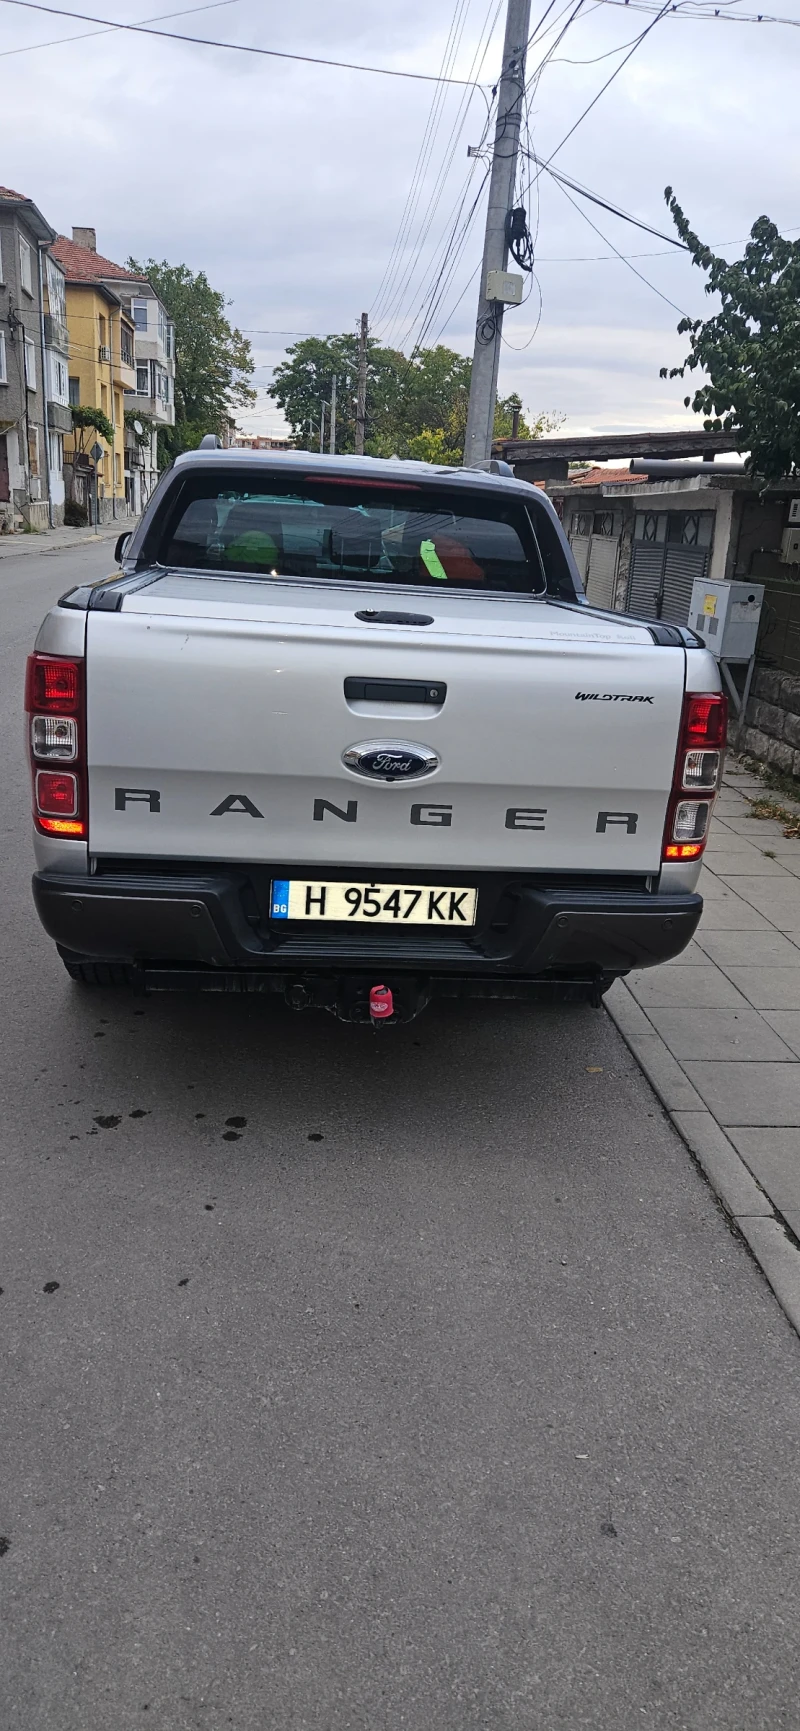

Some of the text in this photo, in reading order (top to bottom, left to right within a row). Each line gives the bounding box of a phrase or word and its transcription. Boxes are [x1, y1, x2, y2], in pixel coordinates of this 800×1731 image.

[550, 631, 611, 640] MountainTop
[575, 692, 655, 704] WILDTRAK
[372, 753, 413, 771] Ford
[115, 788, 638, 834] RANGER
[273, 903, 287, 913] BG
[305, 886, 327, 915] H
[344, 887, 422, 919] 9547
